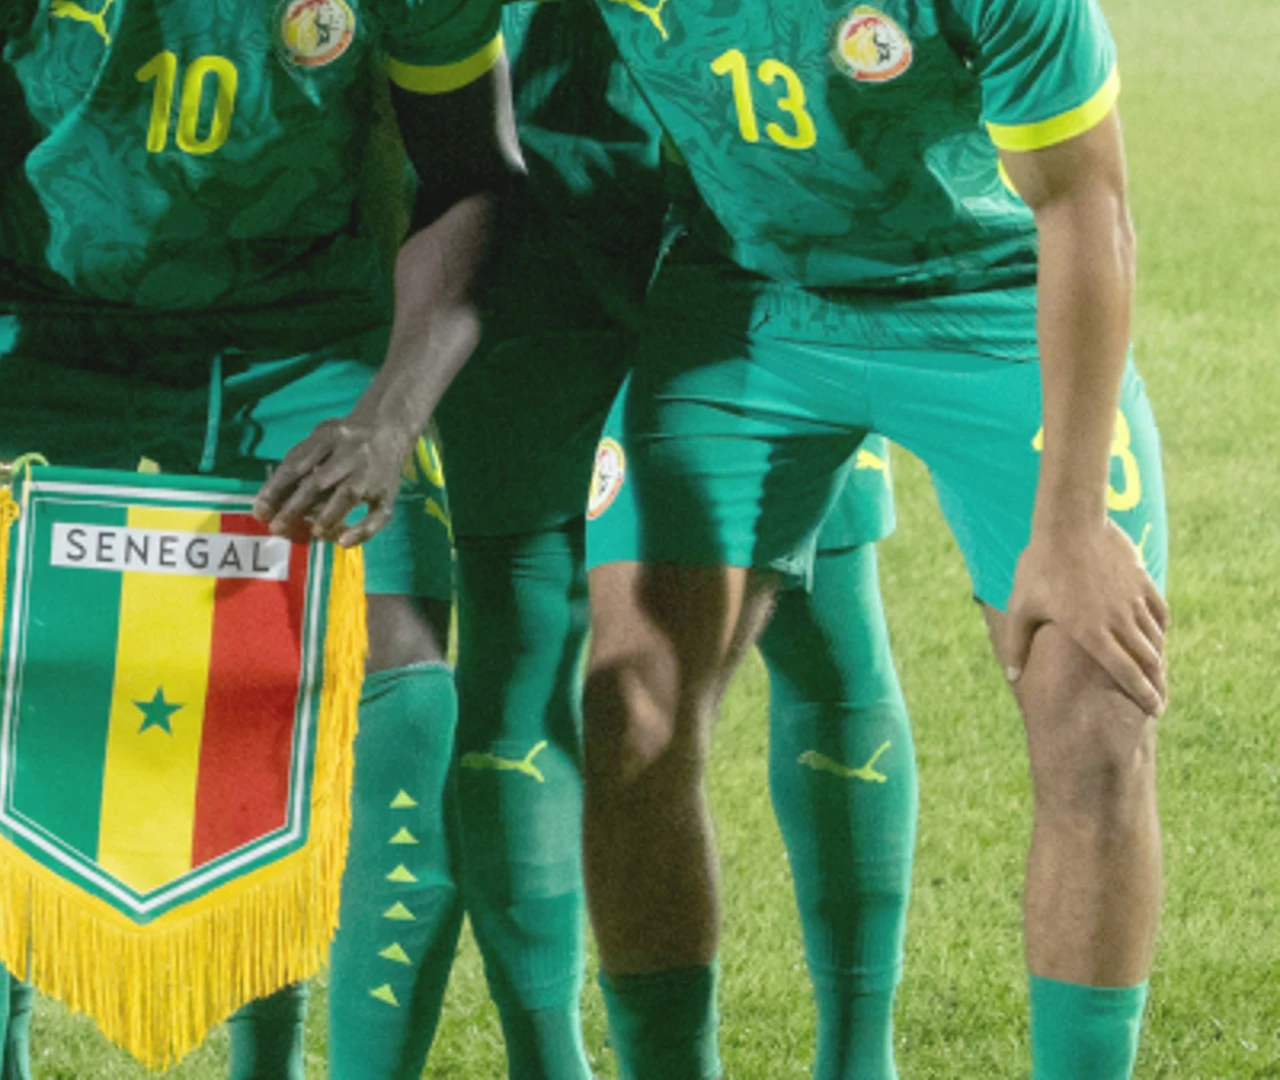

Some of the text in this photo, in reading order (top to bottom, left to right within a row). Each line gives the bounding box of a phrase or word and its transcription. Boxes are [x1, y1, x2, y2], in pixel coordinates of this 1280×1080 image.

[135, 49, 239, 156] 10
[710, 48, 817, 150] 13
[65, 528, 272, 572] SENEGAL
